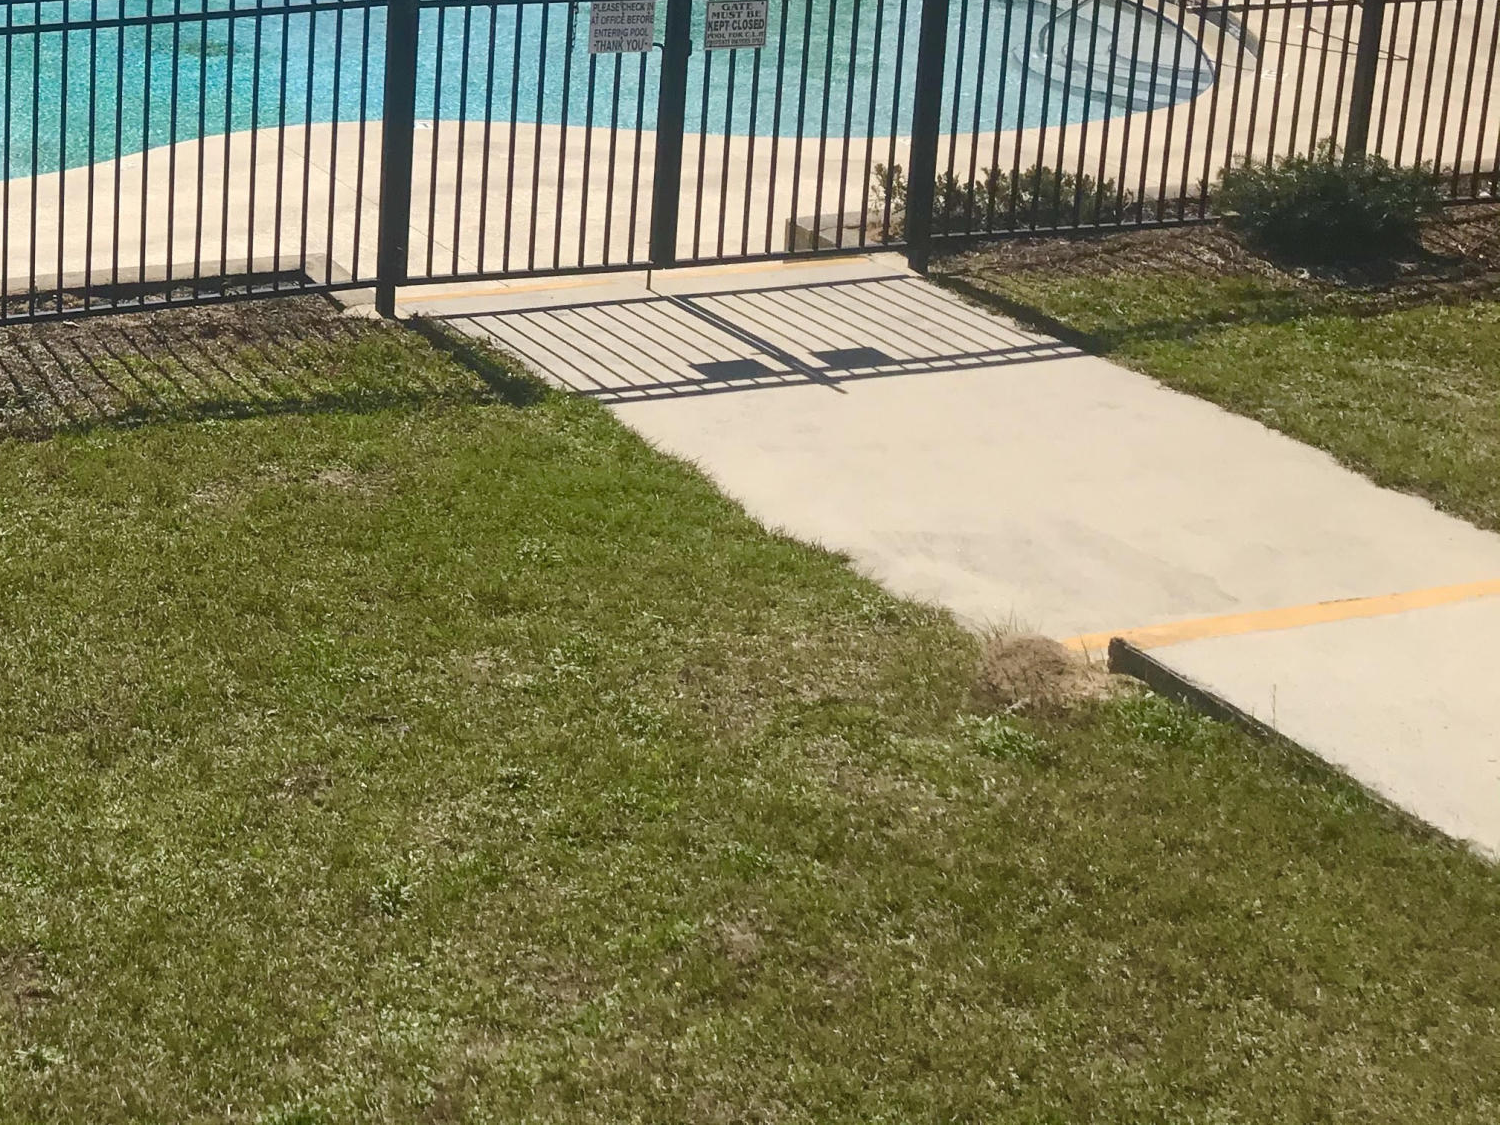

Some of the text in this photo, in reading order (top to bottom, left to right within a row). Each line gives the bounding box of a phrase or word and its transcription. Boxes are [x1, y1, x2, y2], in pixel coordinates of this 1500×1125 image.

[592, 2, 654, 12] PLEASE CHECK IN
[721, 2, 753, 11] GATE
[591, 14, 654, 25] AT OFFICE BEFORE
[711, 10, 762, 20] MUST BE
[707, 18, 765, 32] KEPT CLOSED
[594, 27, 649, 38] ENTERING POOL
